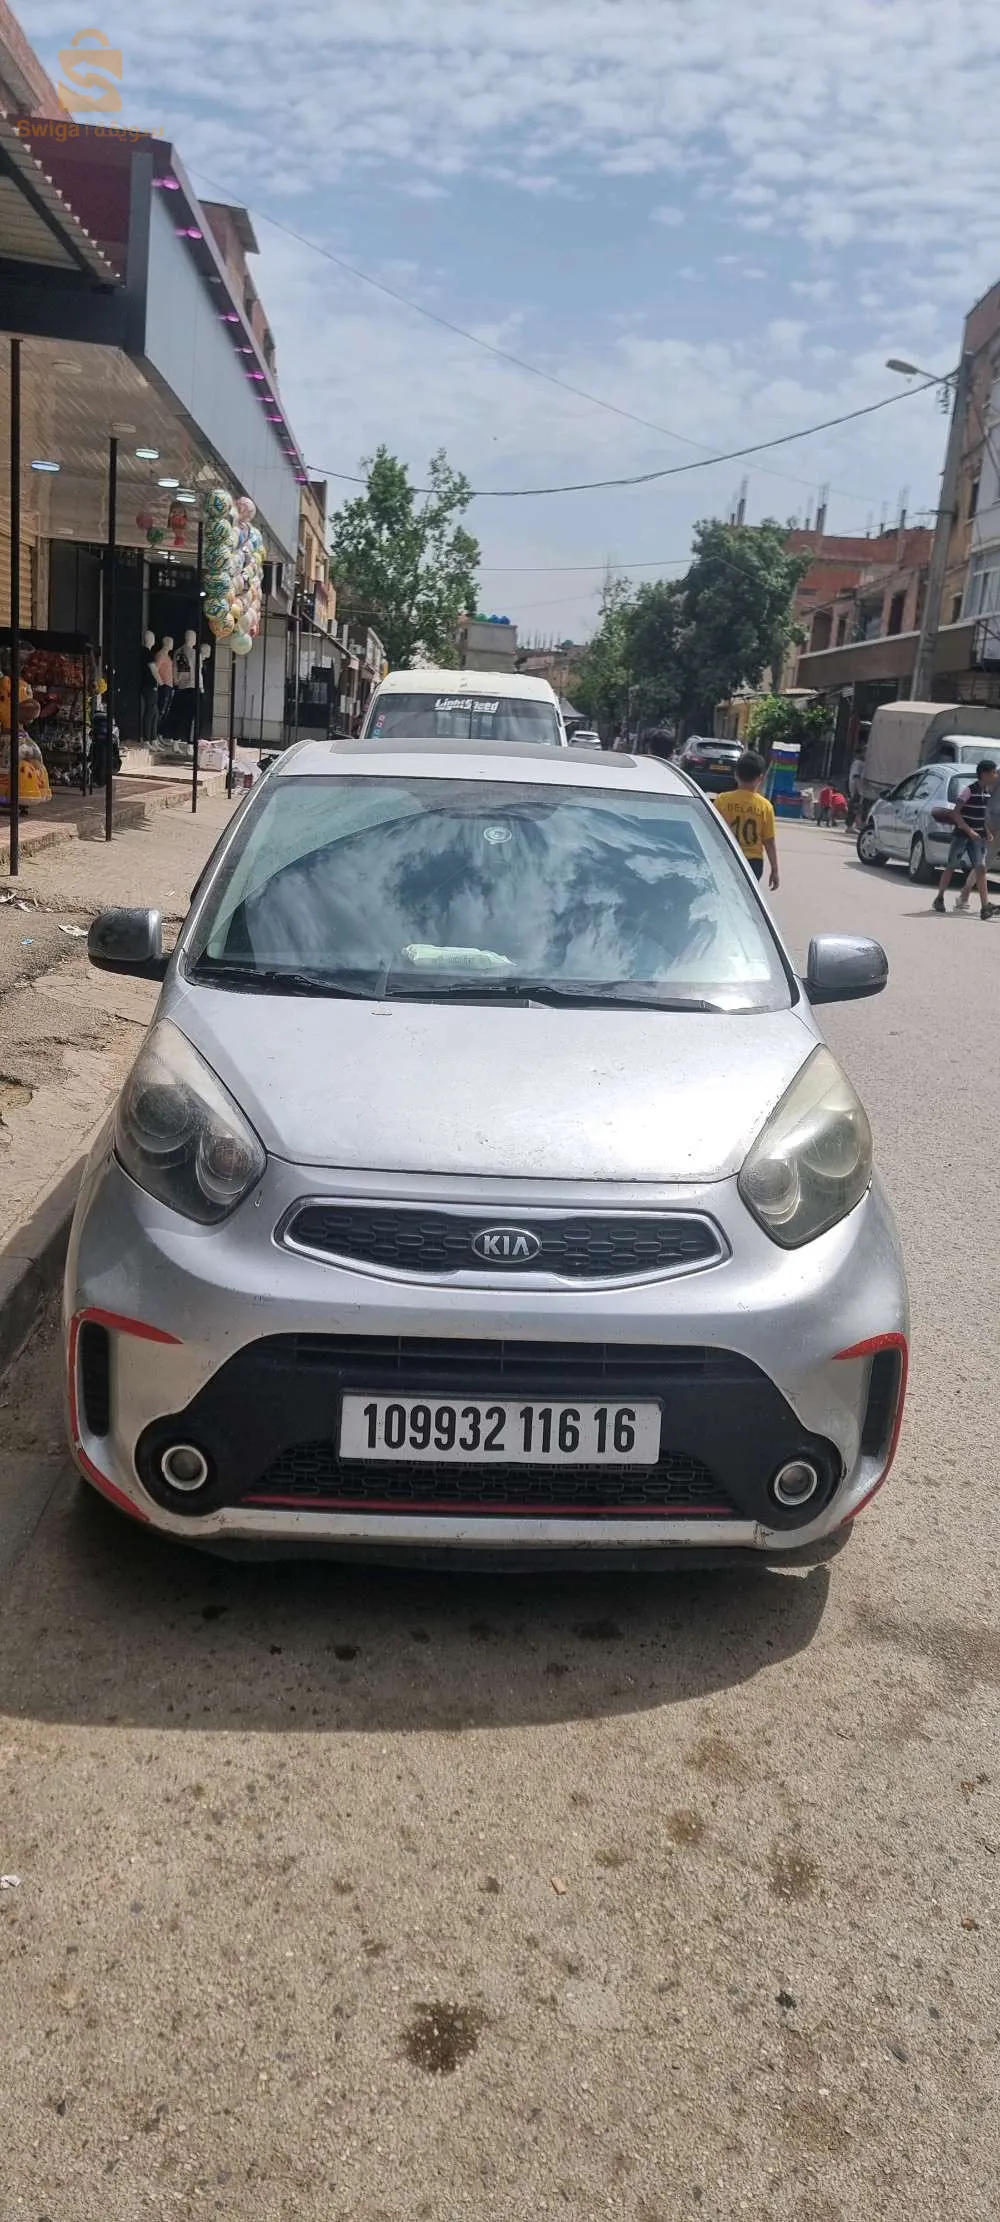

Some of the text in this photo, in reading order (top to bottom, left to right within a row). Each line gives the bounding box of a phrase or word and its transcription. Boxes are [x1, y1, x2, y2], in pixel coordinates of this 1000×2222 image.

[730, 815, 758, 845] 10
[483, 1235, 530, 1256] KIA
[363, 1403, 636, 1453] 109932 116 16
